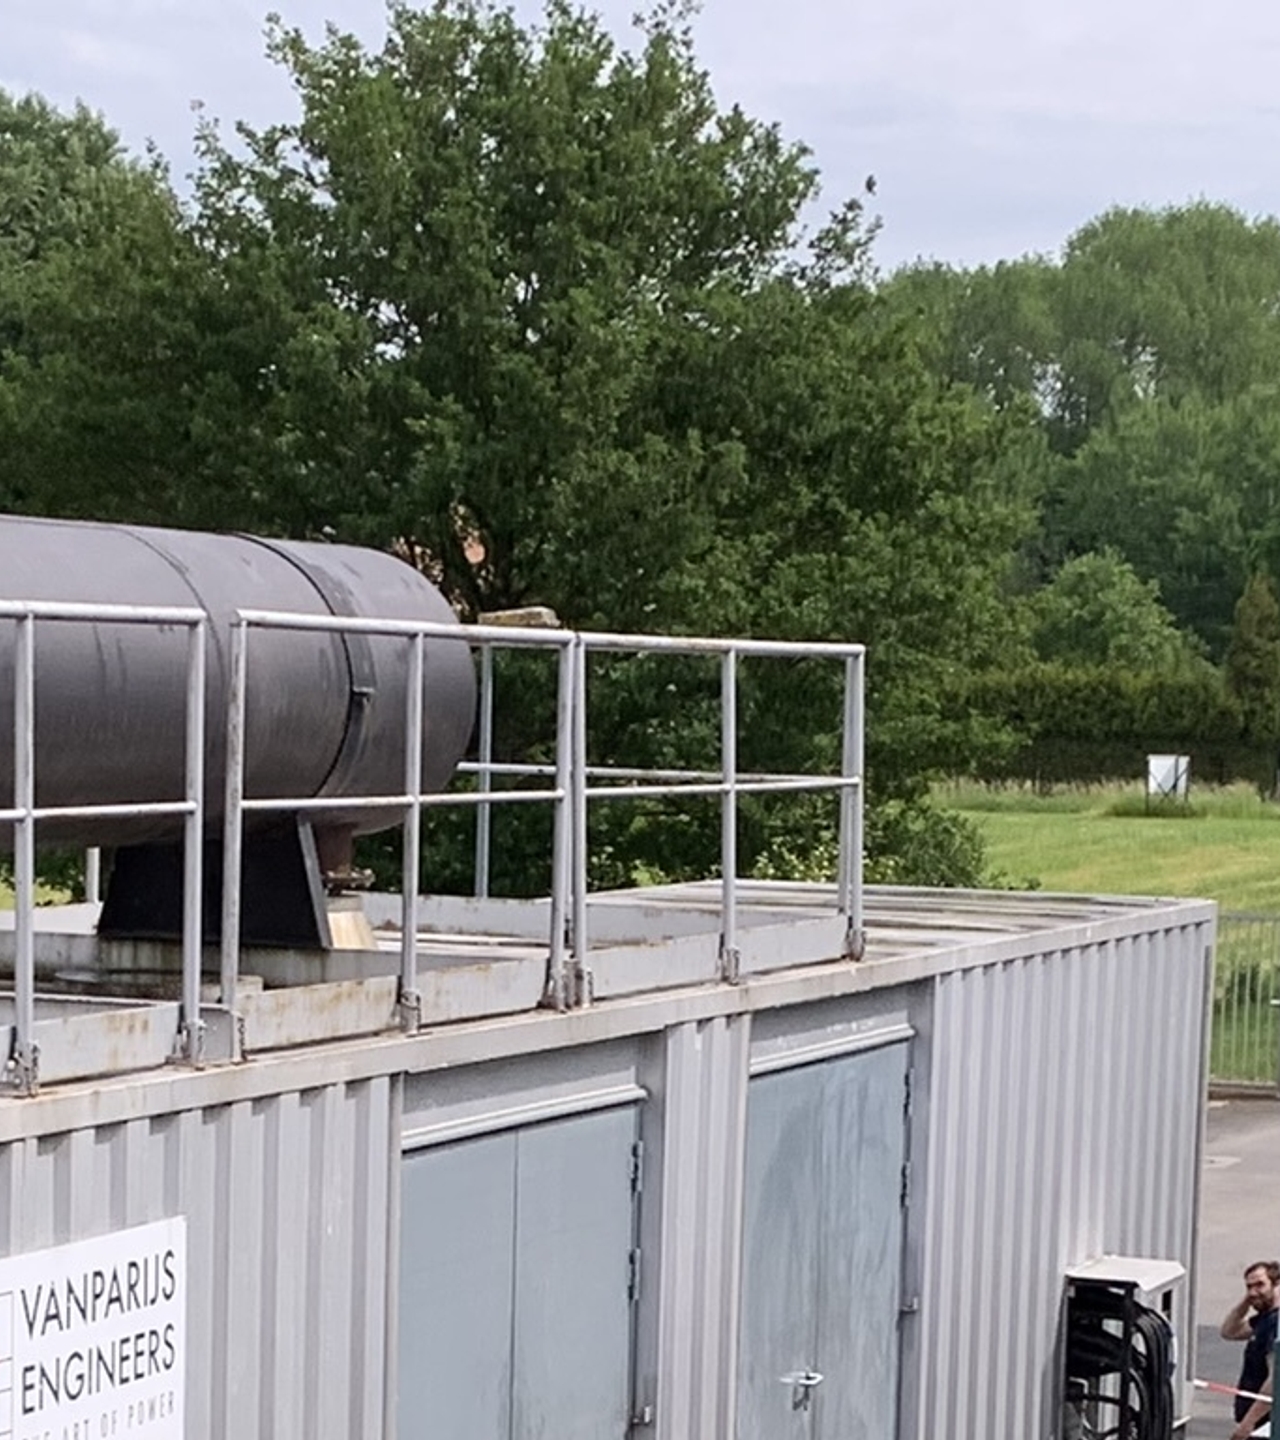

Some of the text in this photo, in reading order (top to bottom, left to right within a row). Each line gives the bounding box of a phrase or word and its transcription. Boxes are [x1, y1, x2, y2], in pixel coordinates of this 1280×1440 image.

[20, 1249, 175, 1341] VANPARIJS
[22, 1323, 175, 1415] ENGINEERS
[100, 1410, 117, 1438] OF
[128, 1391, 174, 1429] POWER
